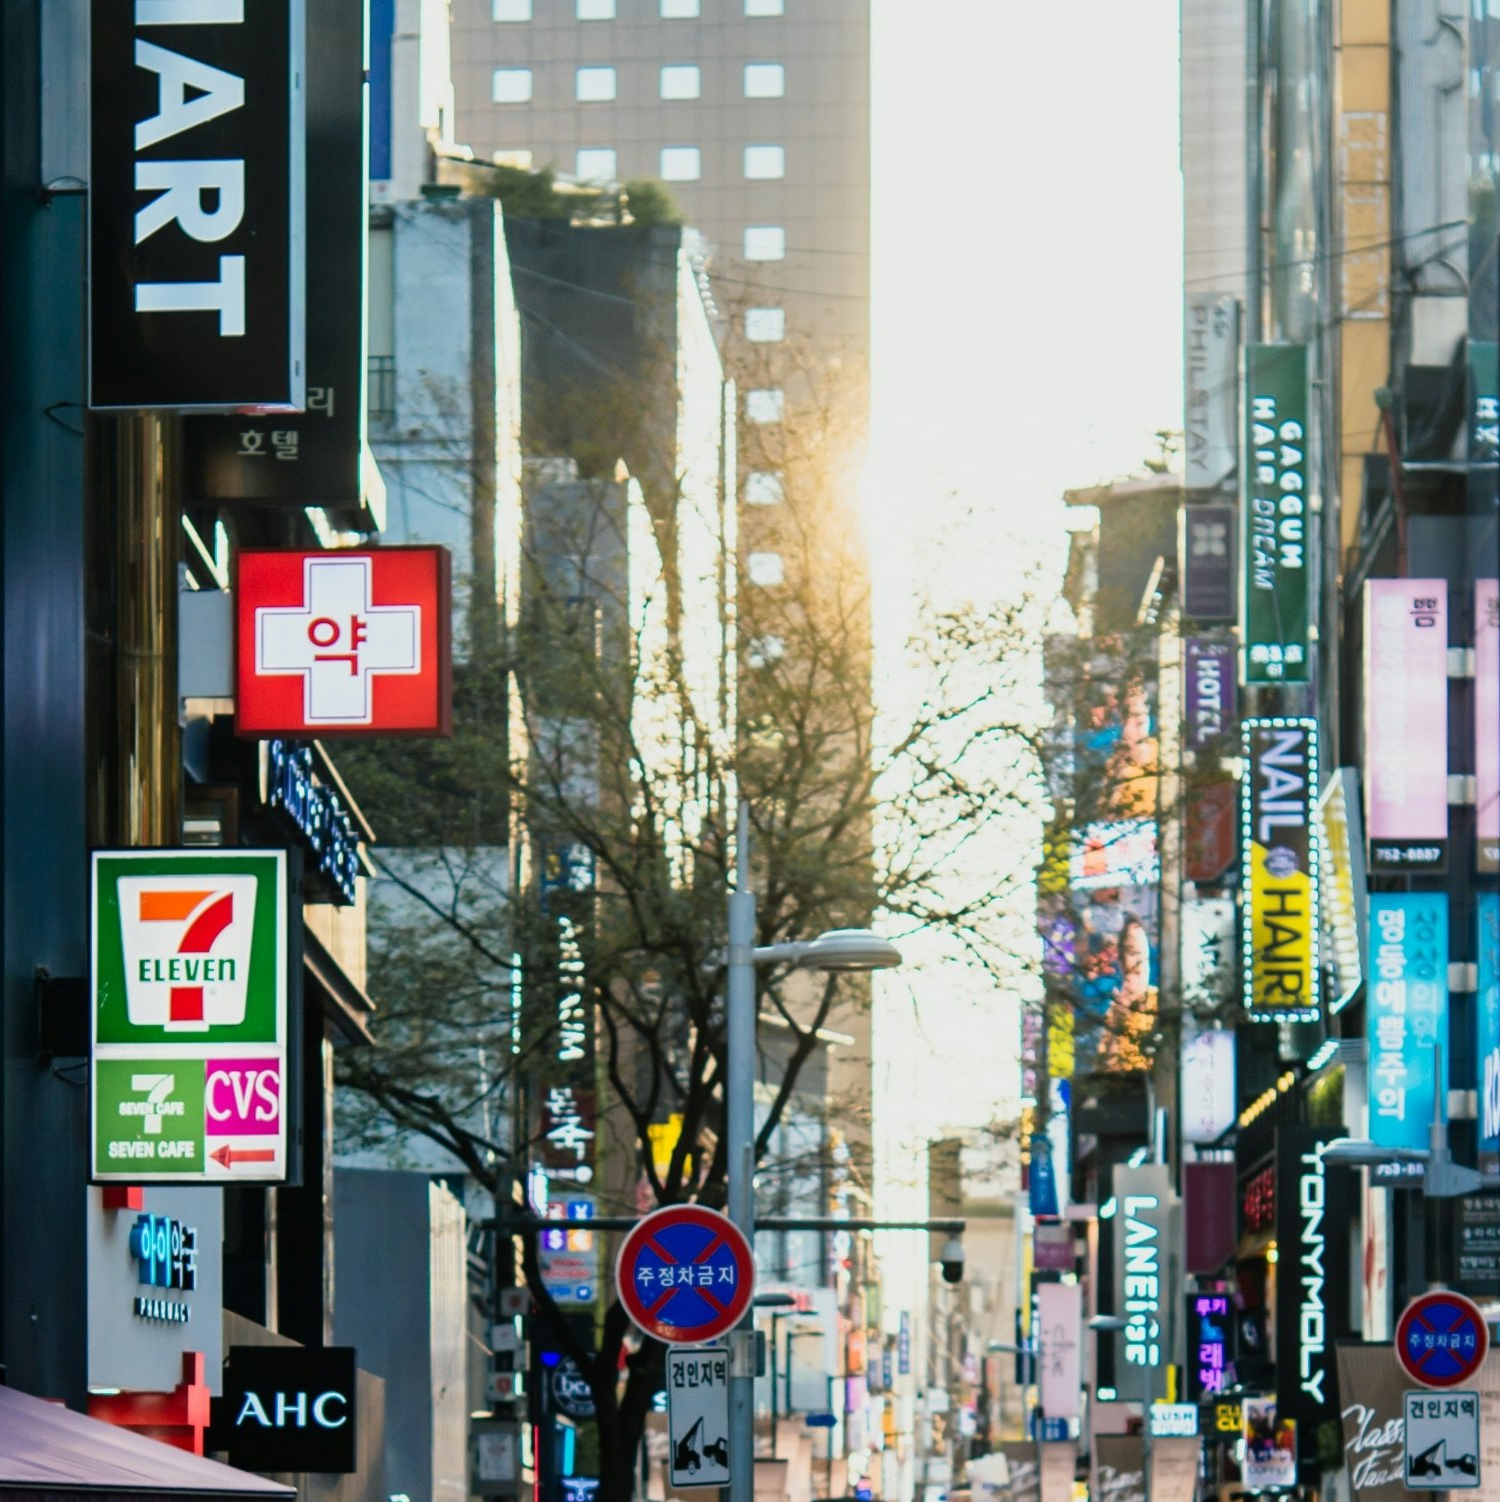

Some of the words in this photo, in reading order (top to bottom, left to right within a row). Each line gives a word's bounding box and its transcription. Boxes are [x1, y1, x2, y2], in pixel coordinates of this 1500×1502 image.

[238, 429, 299, 460] 호텔
[307, 613, 368, 677] 약
[1258, 730, 1304, 842] NAIL
[1263, 888, 1304, 1006] HAIR
[119, 1102, 155, 1116] SEVEN
[156, 1102, 185, 1116] CAFE
[206, 1070, 281, 1123] CVS
[108, 1142, 156, 1160] SEVEN
[158, 1141, 195, 1159] CAFE
[637, 1264, 735, 1287] 주정차금지
[1301, 1142, 1325, 1404] TONYMOLY
[139, 1297, 191, 1322] PHARMACY
[1408, 1333, 1475, 1349] 주정차금지
[672, 1360, 727, 1389] 견인지역
[236, 1391, 347, 1428] AHC
[1410, 1400, 1476, 1419] 견인지역
